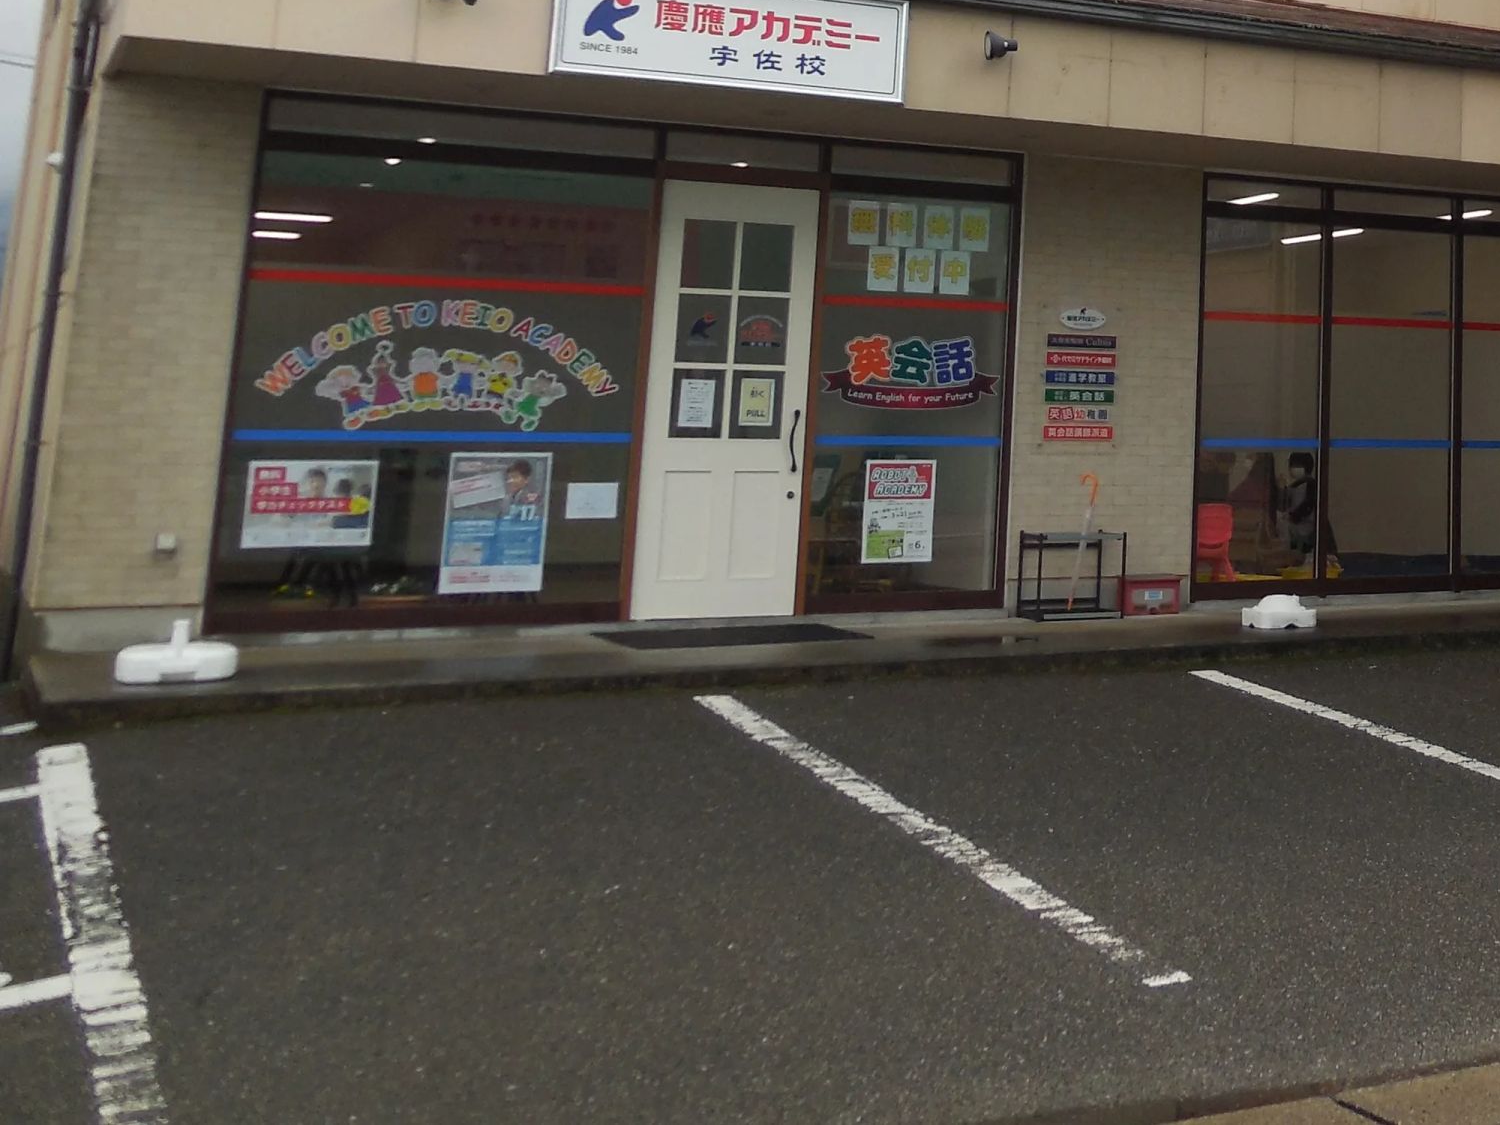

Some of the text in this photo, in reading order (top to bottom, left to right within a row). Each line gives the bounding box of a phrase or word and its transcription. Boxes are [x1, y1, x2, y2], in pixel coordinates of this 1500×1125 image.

[655, 0, 881, 50] 慶應アカデミー
[579, 41, 638, 55] SINCE 1984
[709, 45, 827, 76] 宇佐校
[255, 299, 619, 398] WELCOME TO KEIO ACADEMY
[847, 334, 975, 385] 英会話
[847, 388, 974, 404] Learn English for your Future
[1069, 391, 1105, 401] 英会話
